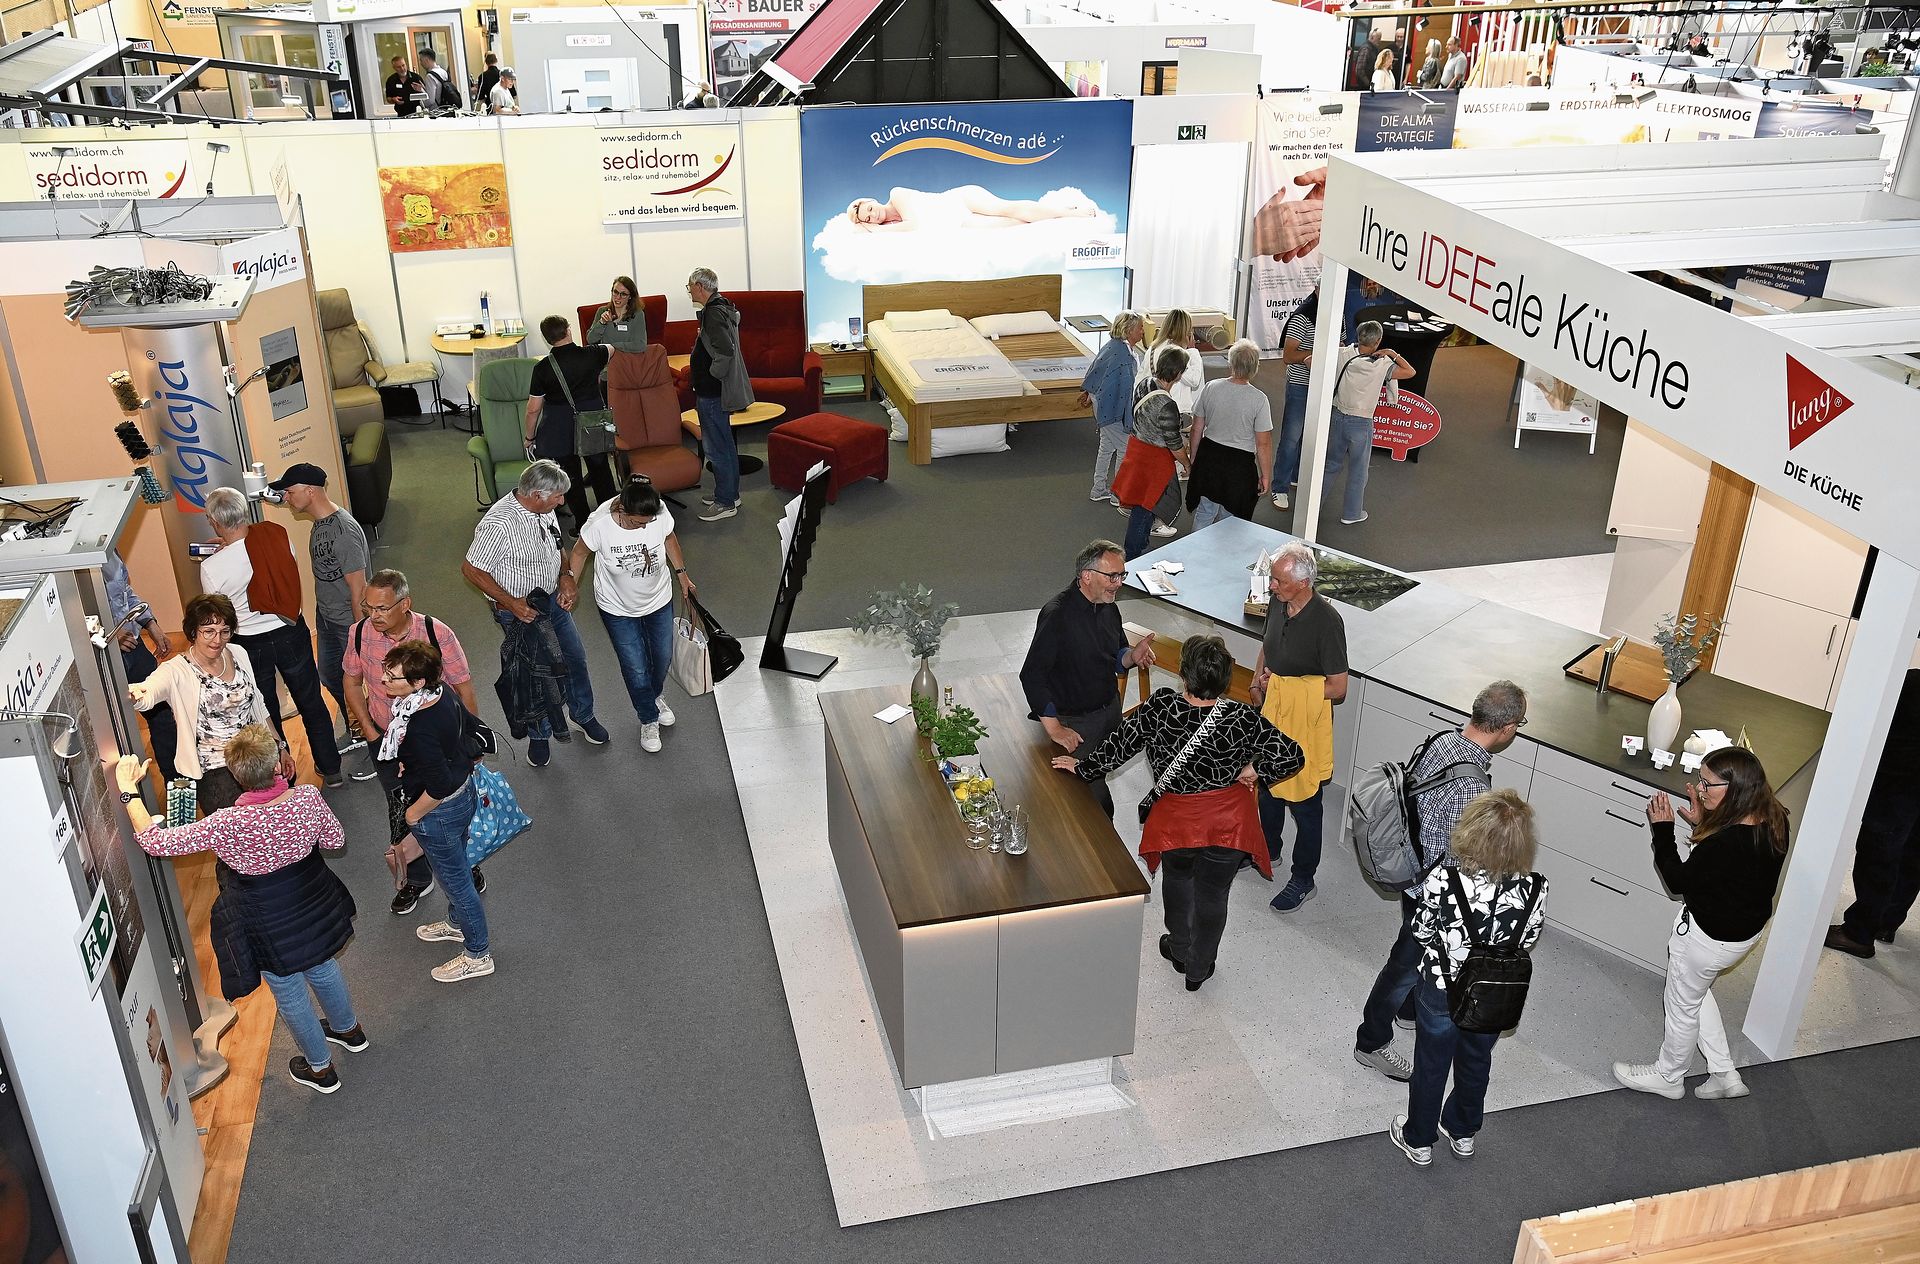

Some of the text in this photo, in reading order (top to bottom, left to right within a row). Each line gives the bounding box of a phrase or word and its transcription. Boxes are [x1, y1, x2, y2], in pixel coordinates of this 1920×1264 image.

[748, 0, 804, 12] BAUER
[712, 21, 782, 29] FASSADENSANIERUNG
[1463, 103, 1525, 113] WASSERAD
[1656, 102, 1752, 122] ELEKTROSMOG
[1273, 112, 1294, 122] Wie
[1380, 114, 1434, 127] DIE ALMA
[600, 131, 682, 142] www.sedidorm.ch
[870, 115, 1013, 148] Rückenschmerzen
[1017, 132, 1047, 149] adé
[1283, 127, 1332, 139] sind Sie?
[1375, 130, 1435, 144] STRATEGIE
[1282, 143, 1311, 151] machen
[1329, 142, 1343, 150] Test
[602, 147, 699, 170] sedidorm
[36, 163, 148, 188] sedidorm
[645, 172, 660, 180] und
[661, 170, 700, 180] ruhemöbel
[88, 191, 104, 199] und
[106, 188, 150, 198] ruhemöbel
[619, 206, 635, 216] und
[637, 206, 653, 215] das
[655, 205, 679, 214] leben
[681, 203, 700, 213] wird
[702, 202, 739, 213] bequem.
[1746, 268, 1806, 285] Rheuma, Knochen,
[1266, 299, 1290, 308] Unser
[1359, 204, 1689, 410] Ihre IDEEale Küche
[1271, 310, 1287, 321] lügt
[1398, 393, 1434, 416] rdstrahlen
[1374, 416, 1433, 431] stet sind Sie?
[155, 360, 233, 508] Aglaja
[1388, 430, 1412, 438] Beratung
[1784, 460, 1863, 512] DIE KÜCHE
[611, 543, 643, 554] FREE SPIRIT
[56, 817, 67, 842] 166
